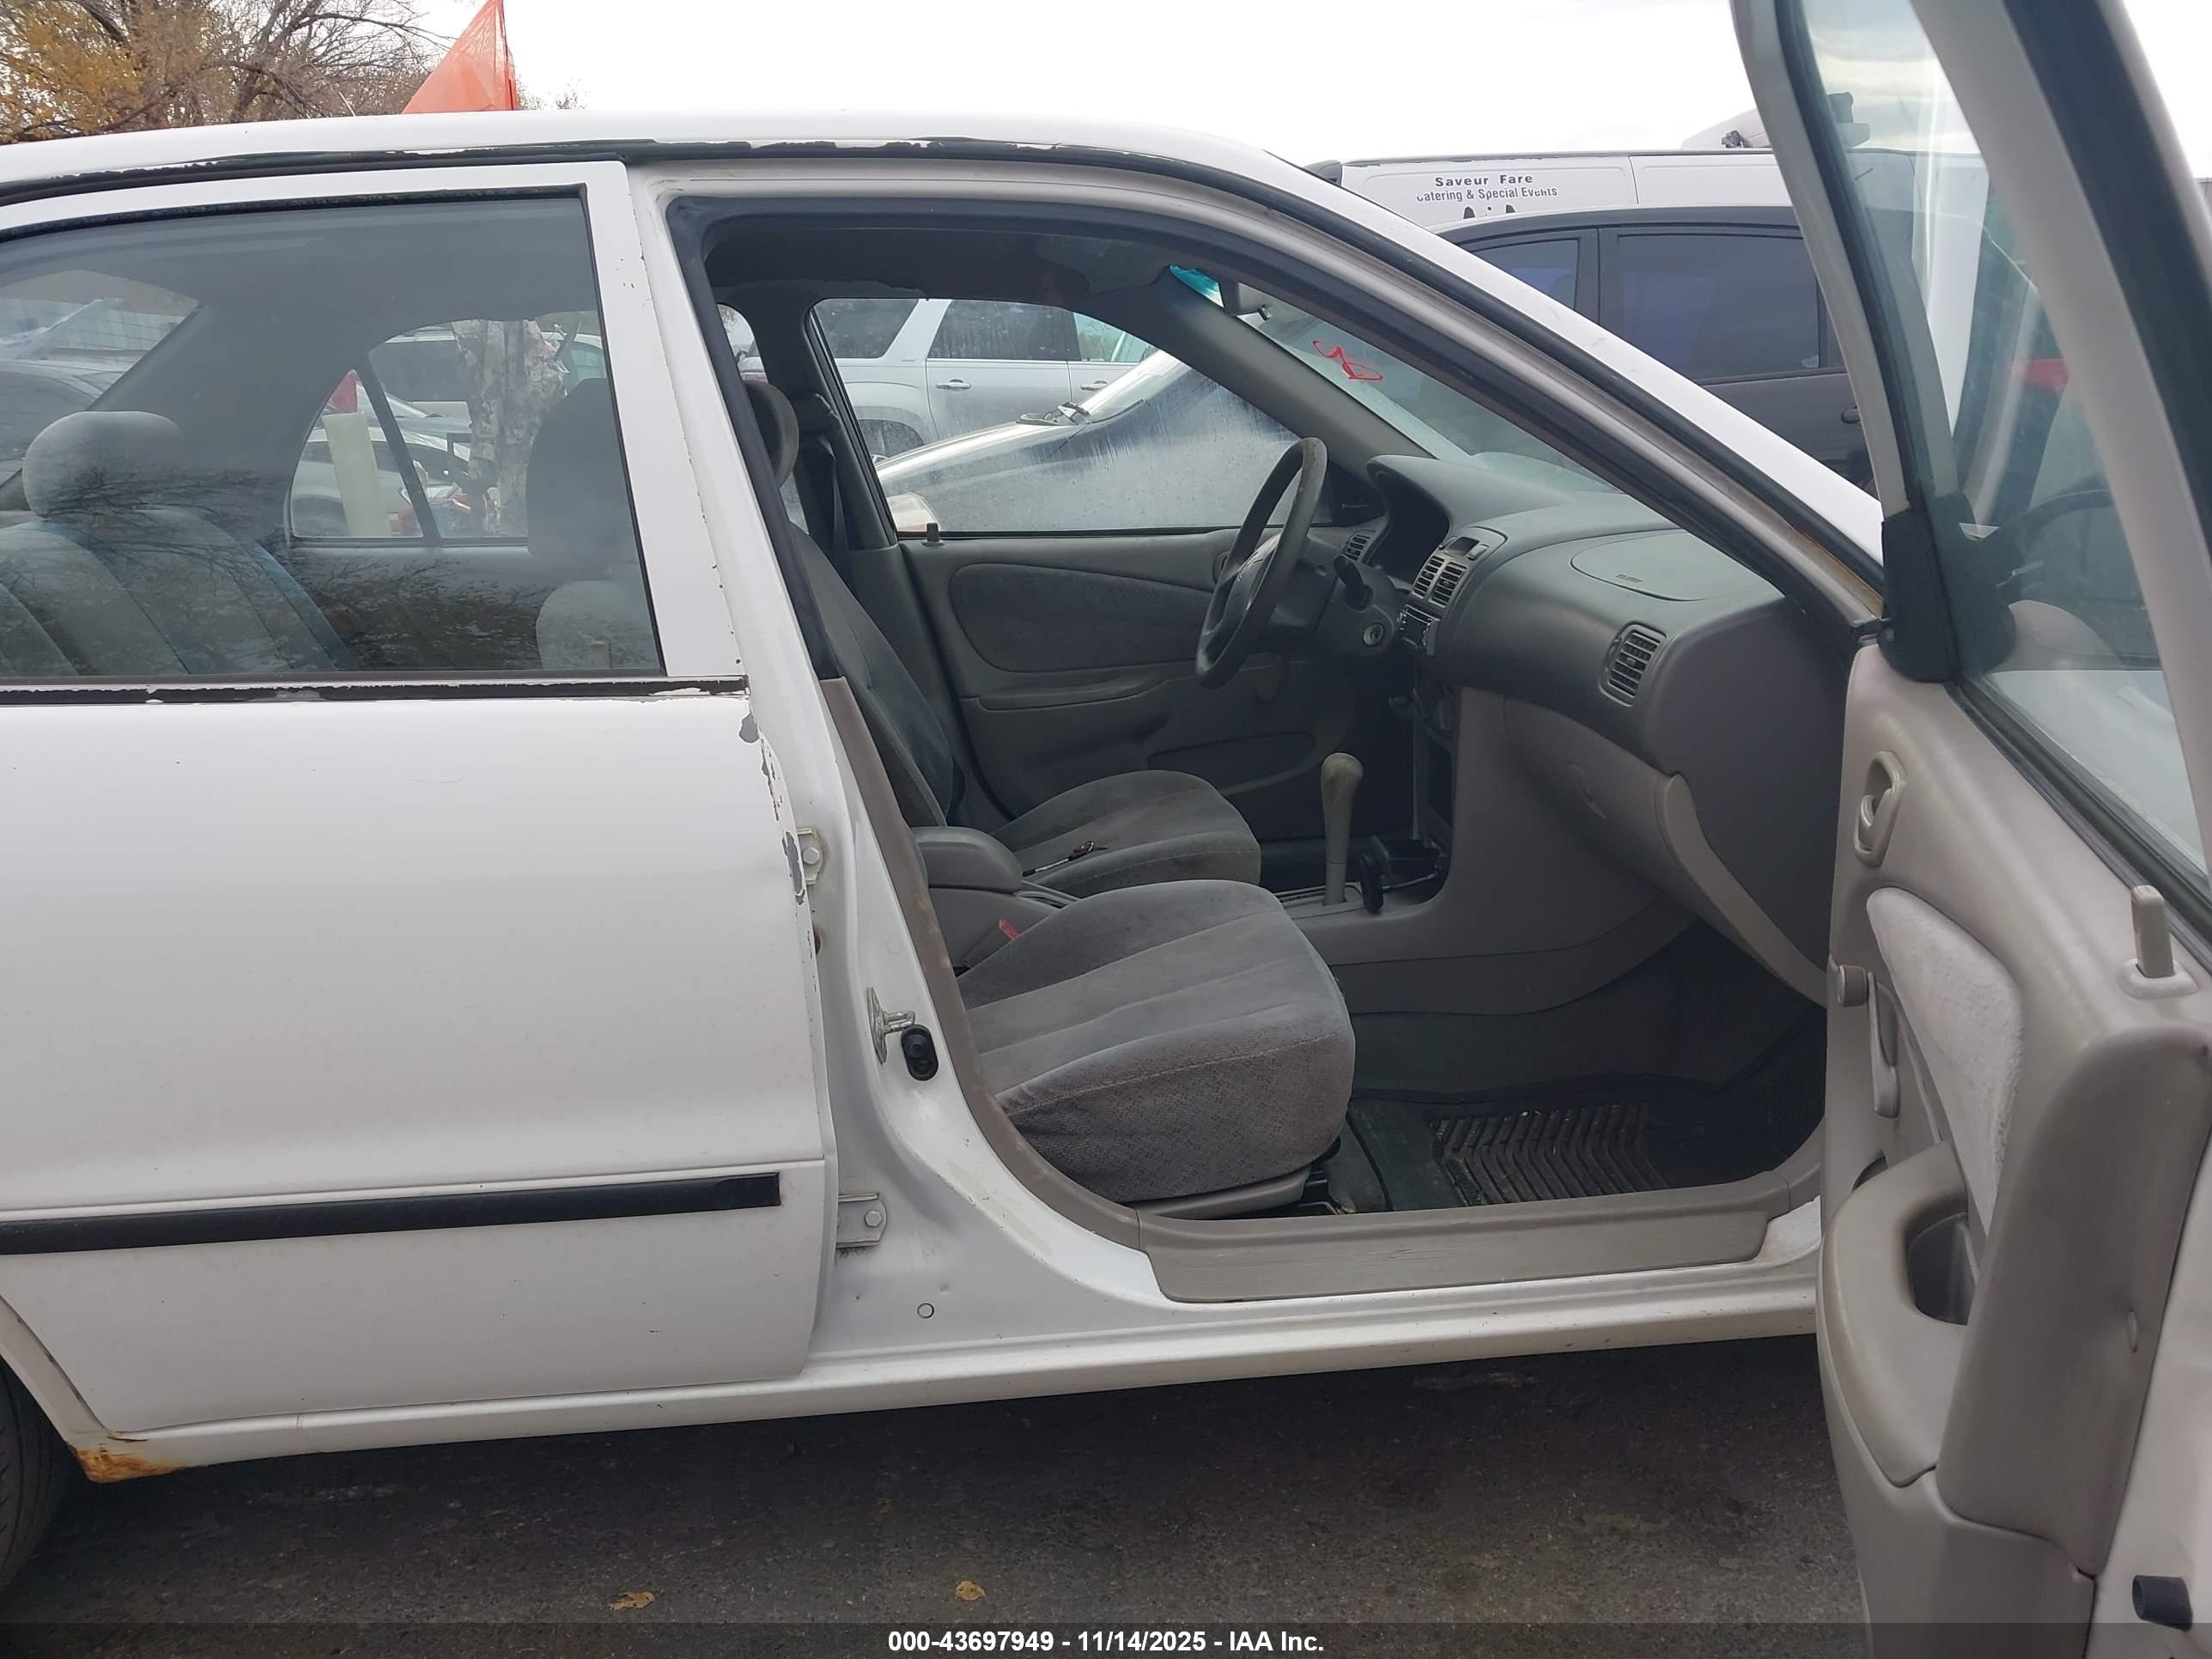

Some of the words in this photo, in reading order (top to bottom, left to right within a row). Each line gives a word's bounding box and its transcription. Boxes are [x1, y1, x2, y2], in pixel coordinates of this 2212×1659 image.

[1435, 177, 1489, 187] Saveur
[1499, 174, 1533, 184] Fare
[1466, 189, 1475, 199] &
[1478, 187, 1518, 201] Special
